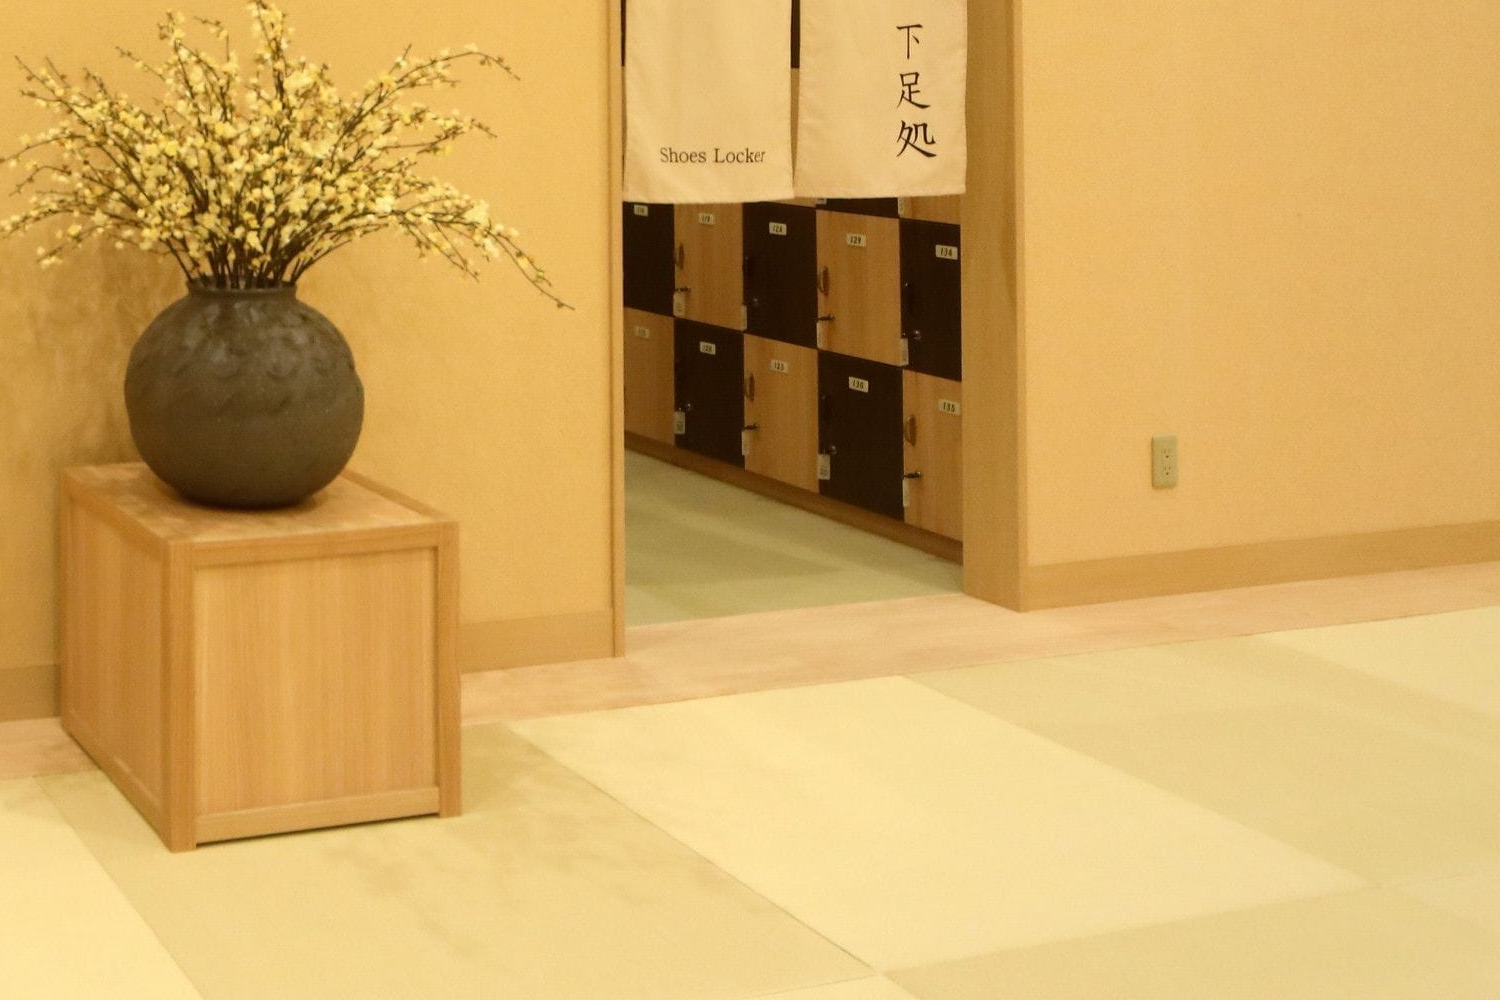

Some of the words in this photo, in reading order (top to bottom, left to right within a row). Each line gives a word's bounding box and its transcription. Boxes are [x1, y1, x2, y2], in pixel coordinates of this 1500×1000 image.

[895, 22, 938, 159] 下足処
[659, 147, 707, 164] Shoes
[713, 147, 766, 164] Locker
